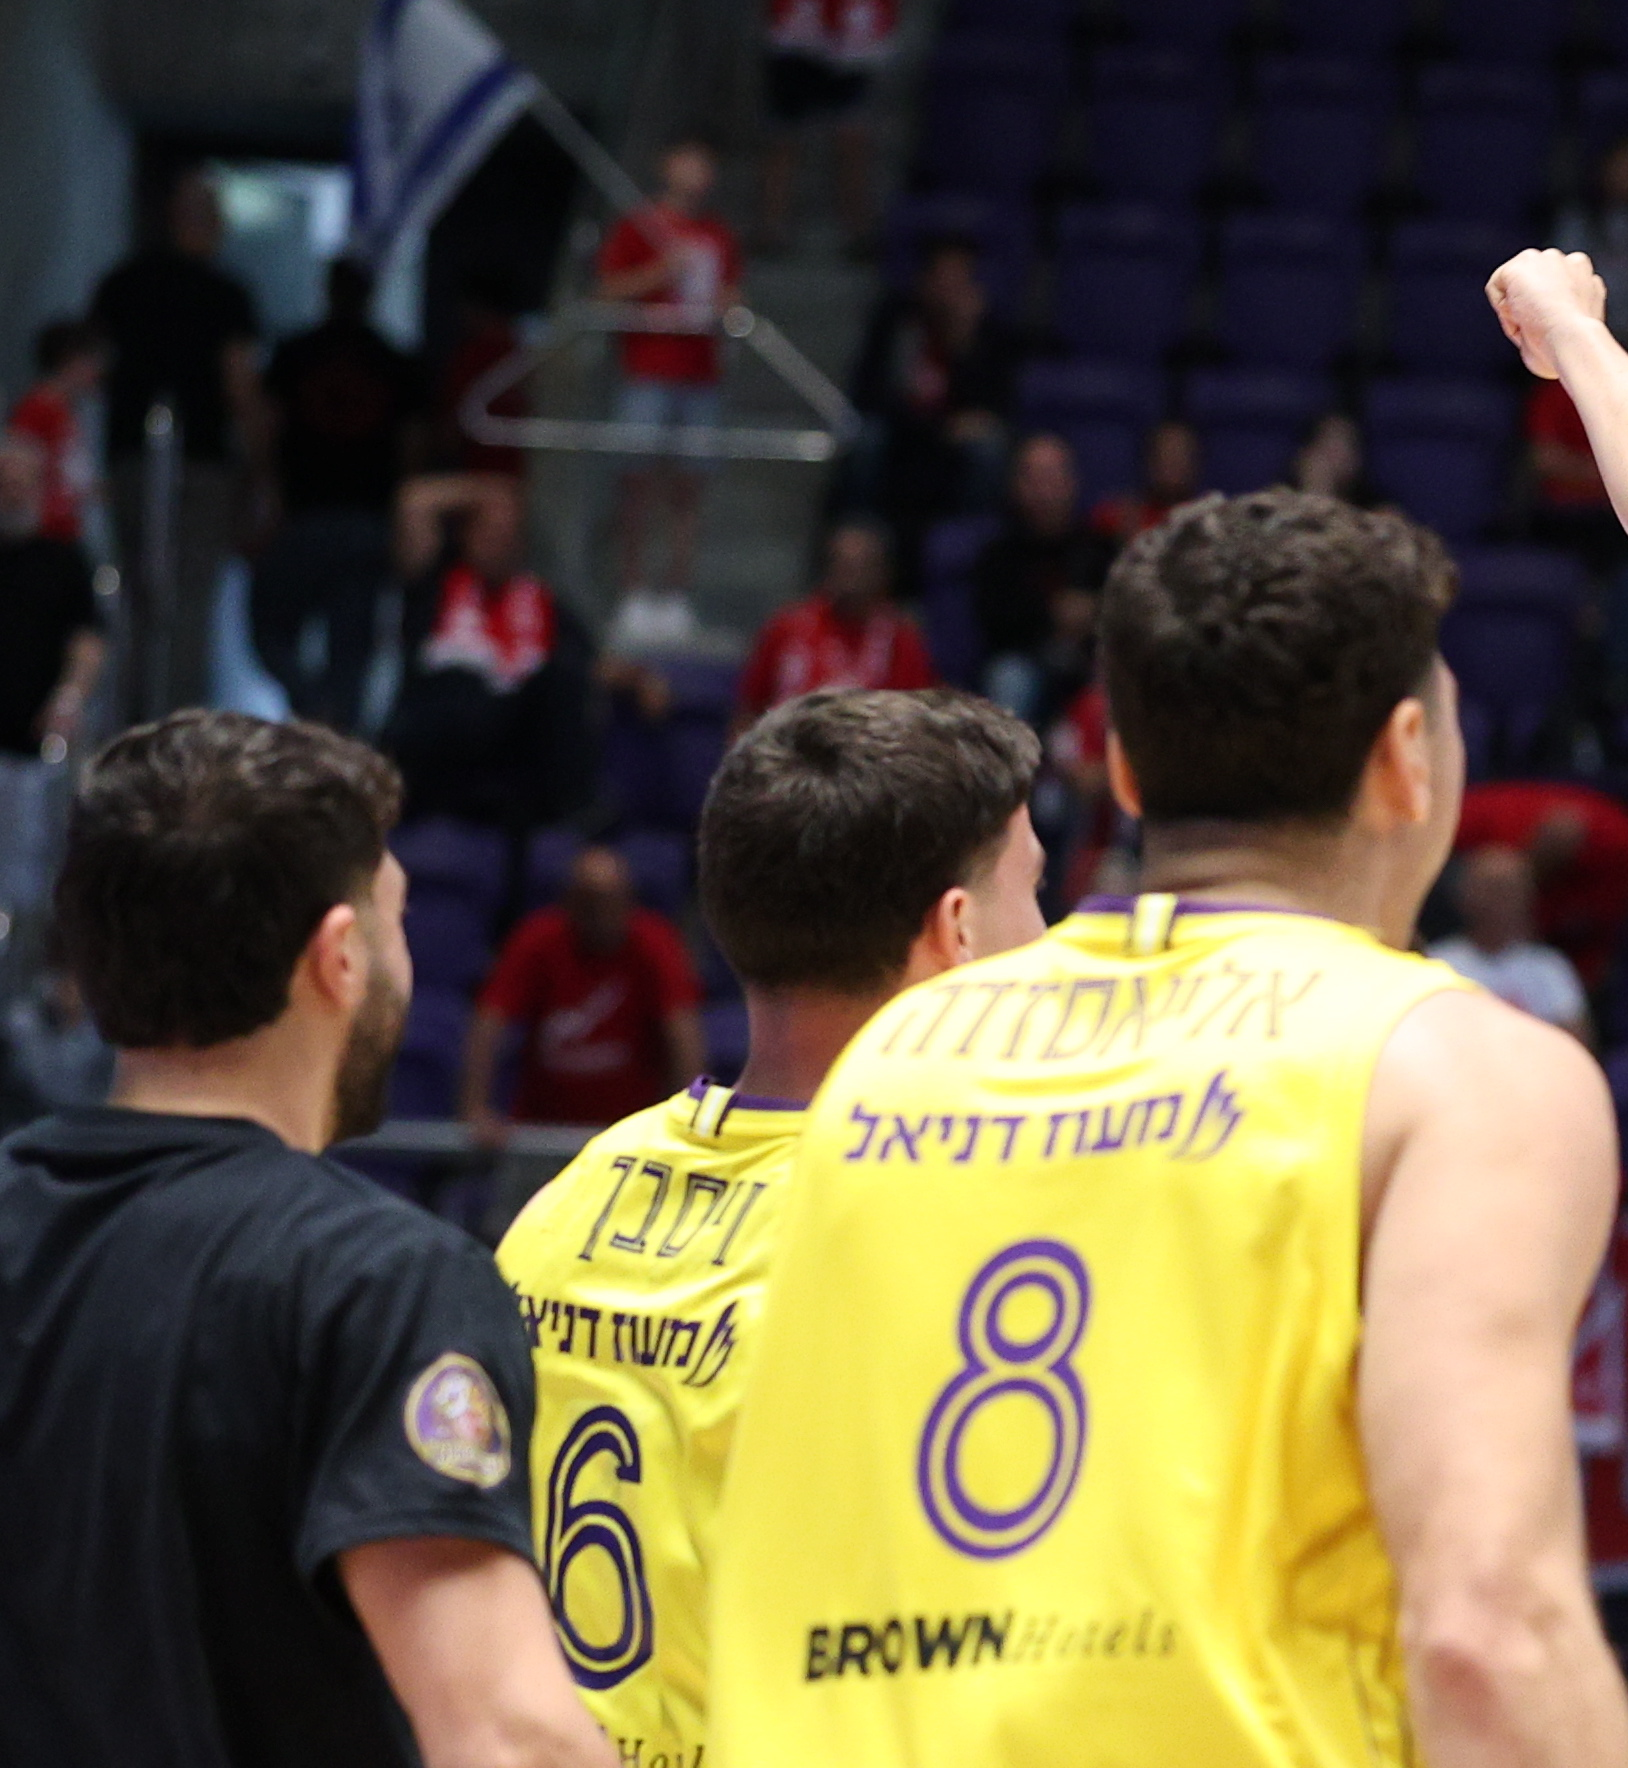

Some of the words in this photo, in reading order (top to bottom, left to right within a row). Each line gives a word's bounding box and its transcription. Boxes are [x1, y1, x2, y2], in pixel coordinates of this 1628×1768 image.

[845, 1103, 1027, 1162] דניאל
[612, 1312, 702, 1367] מעוז
[915, 1237, 1092, 1561] 8
[545, 1404, 654, 1691] 6
